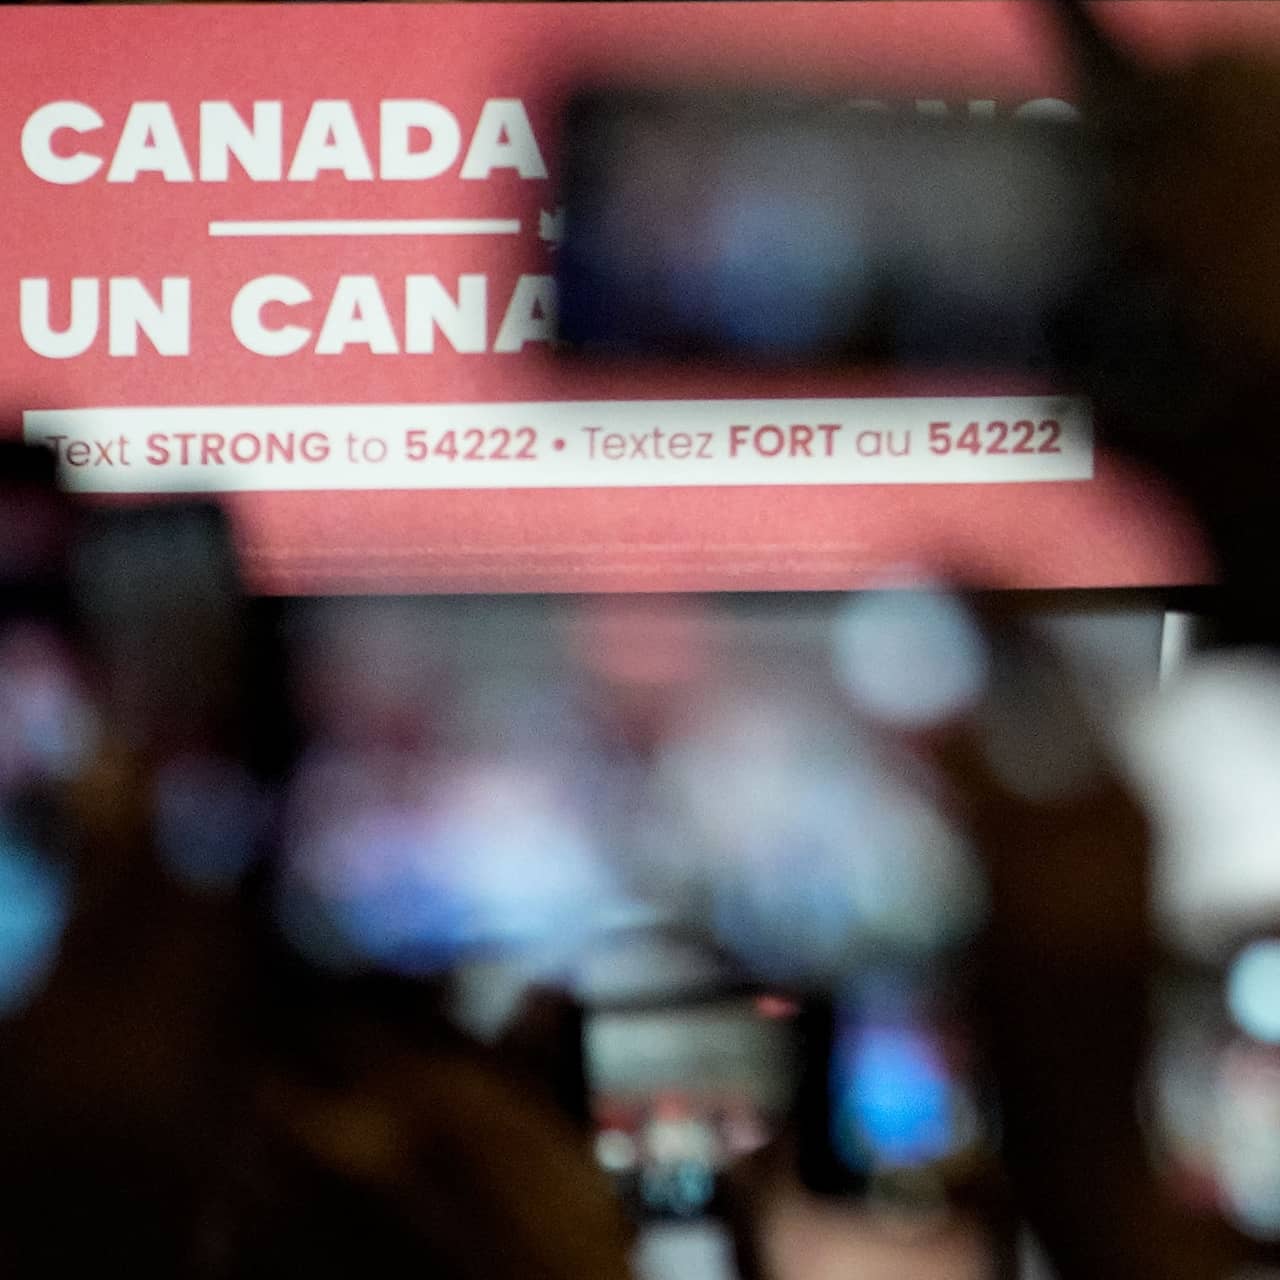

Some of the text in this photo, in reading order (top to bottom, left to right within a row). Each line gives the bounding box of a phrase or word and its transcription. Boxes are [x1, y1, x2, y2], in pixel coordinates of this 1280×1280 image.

[20, 98, 549, 185] CANADA
[20, 276, 191, 360] UN
[46, 419, 1063, 468] Text STRONG to 54222 Textez FORT au 54222
